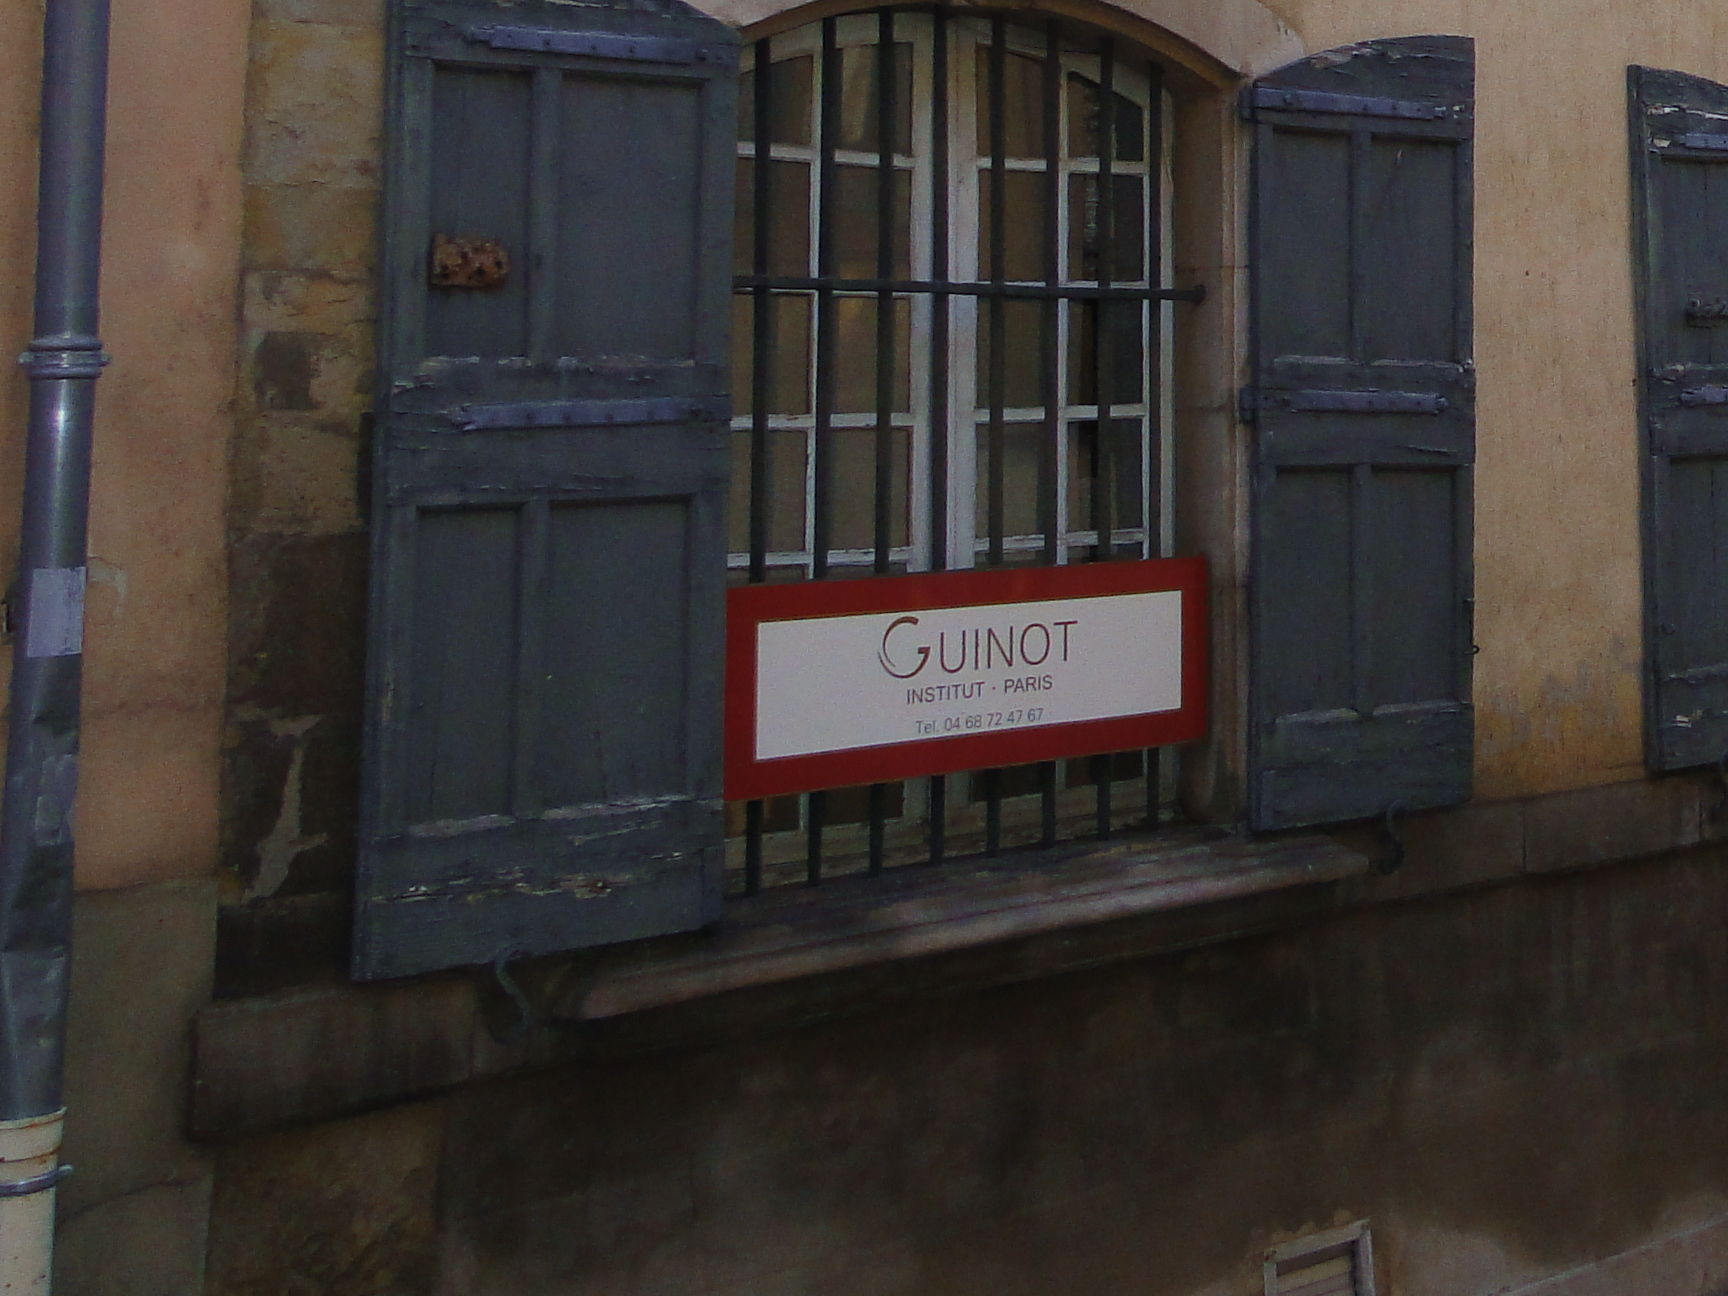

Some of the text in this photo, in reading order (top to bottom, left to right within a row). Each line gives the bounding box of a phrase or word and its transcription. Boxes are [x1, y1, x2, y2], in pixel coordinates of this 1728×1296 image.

[877, 615, 1079, 679] GUINOT
[906, 681, 985, 705] INSTITUT
[1004, 674, 1053, 695] PARIS
[944, 716, 960, 732] 04
[965, 714, 982, 729] 68
[987, 712, 1003, 727] 72
[1007, 709, 1023, 725] 47
[1027, 707, 1044, 722] 67
